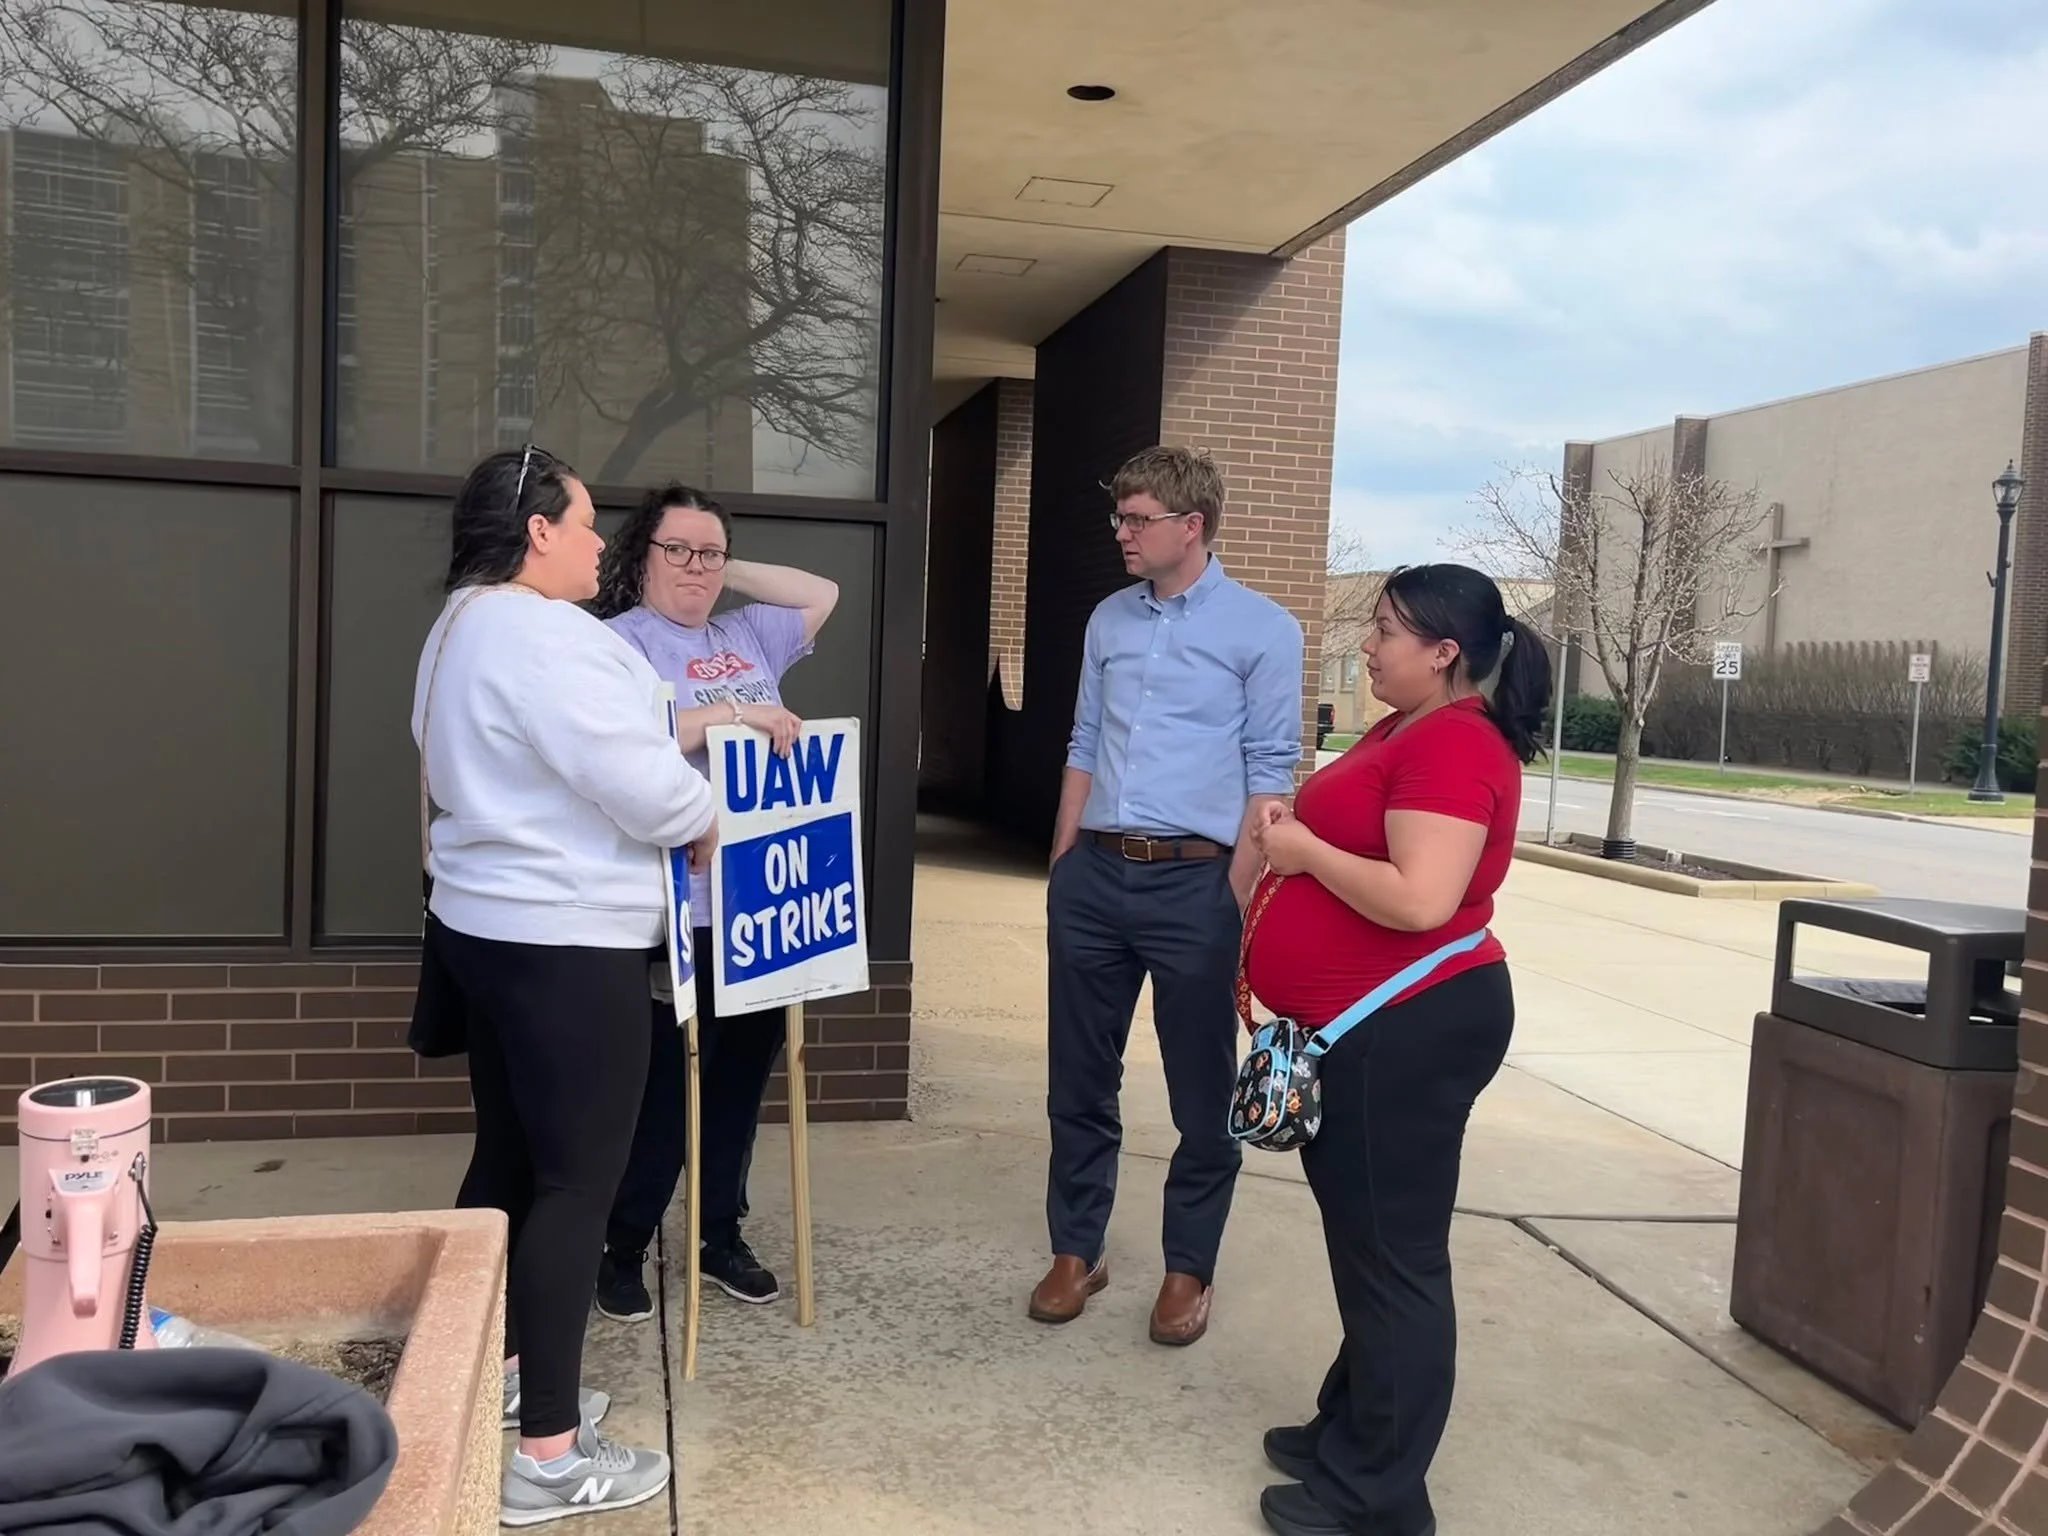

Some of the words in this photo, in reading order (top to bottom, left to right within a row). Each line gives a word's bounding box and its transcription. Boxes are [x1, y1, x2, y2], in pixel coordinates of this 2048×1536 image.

[1716, 660, 1738, 674] 25
[724, 734, 845, 813] UAW
[765, 835, 809, 895] ON
[731, 882, 854, 968] STRIKE
[65, 1171, 103, 1181] PYLE
[570, 1477, 614, 1503] N
